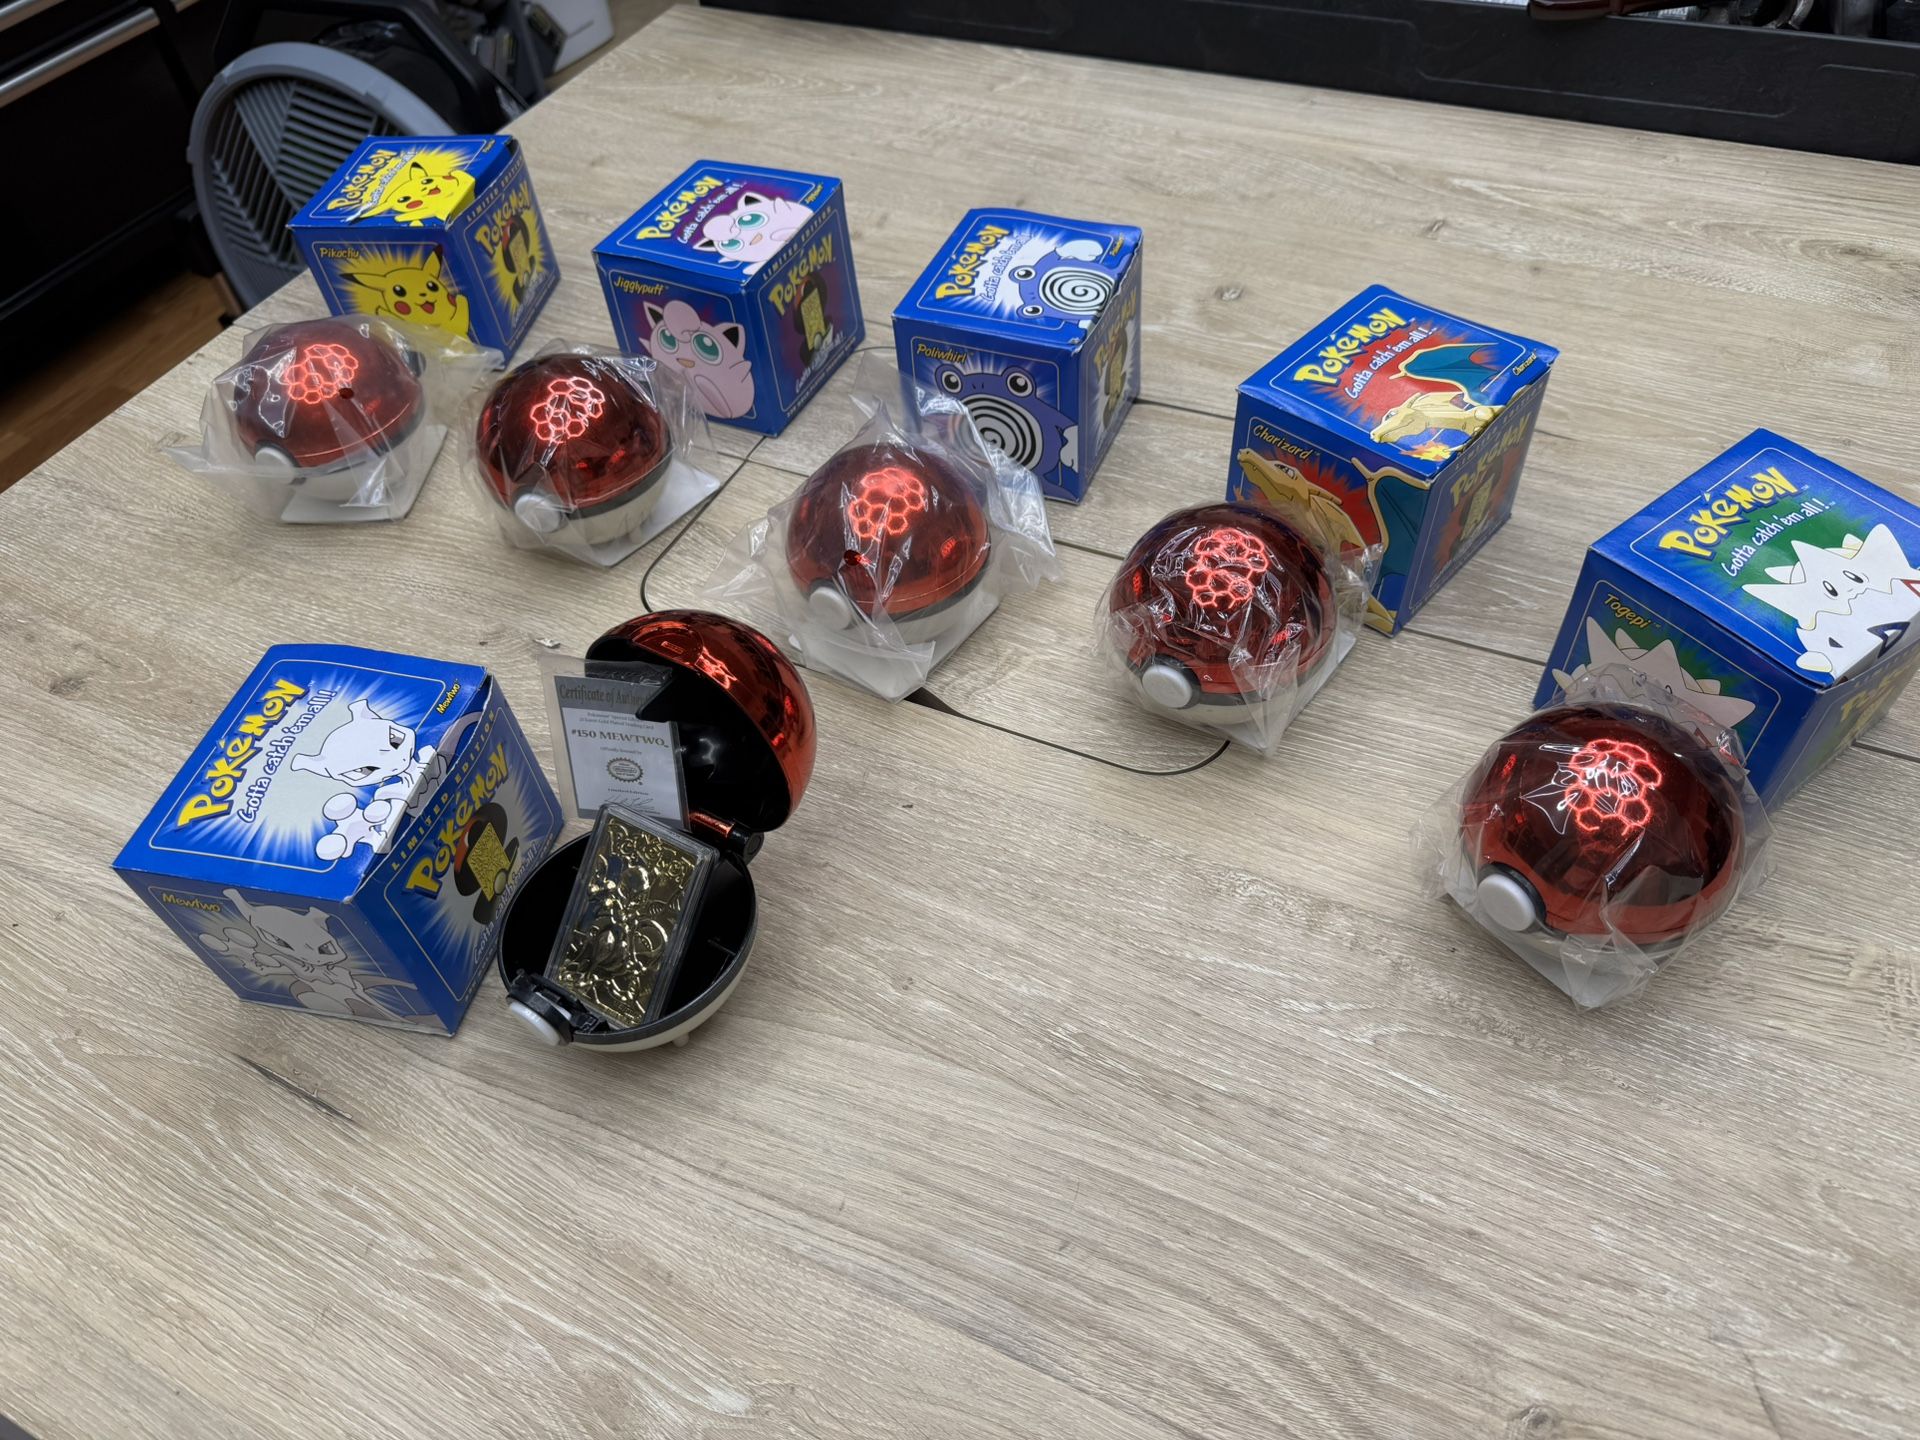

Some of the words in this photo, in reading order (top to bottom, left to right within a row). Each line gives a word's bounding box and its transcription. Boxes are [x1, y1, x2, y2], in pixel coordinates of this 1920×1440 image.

[319, 247, 360, 260] Pikachu
[613, 276, 665, 295] Jigglypuff
[916, 343, 968, 364] Poliwhirl
[1344, 369, 1373, 399] Gotta
[1369, 348, 1394, 371] catch
[1253, 424, 1312, 460] Charizard
[1721, 544, 1757, 578] Gotta
[1752, 519, 1783, 547] catch
[1604, 593, 1652, 629] Togepi
[436, 683, 460, 714] Mewtwo
[559, 684, 605, 704] Certificate
[571, 728, 596, 739] #150
[599, 730, 665, 746] MEWTWO
[238, 777, 271, 823] Gotta
[264, 736, 295, 775] catch
[391, 792, 449, 871] LIMITED
[454, 710, 495, 784] EDITION
[162, 893, 220, 912] Mewtwo
[473, 920, 494, 965] Gotta
